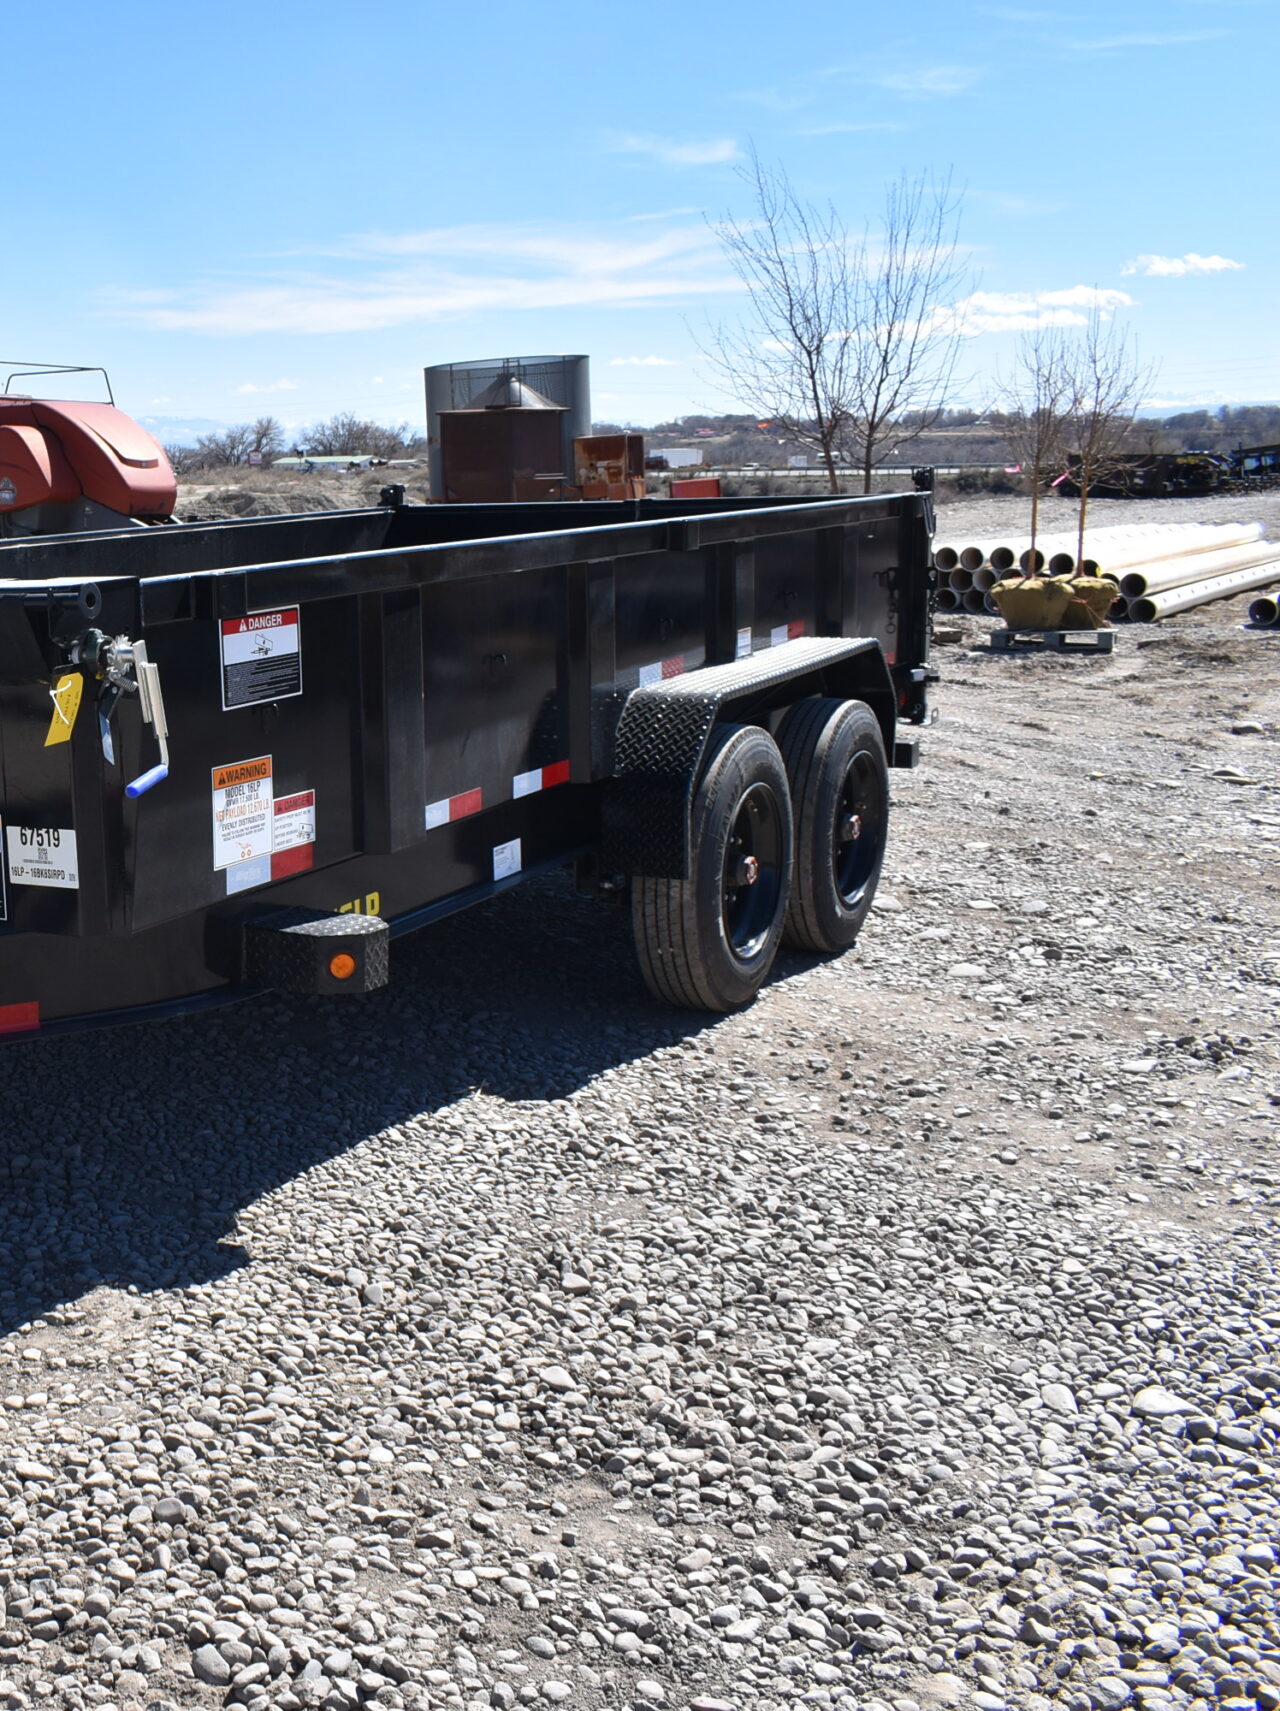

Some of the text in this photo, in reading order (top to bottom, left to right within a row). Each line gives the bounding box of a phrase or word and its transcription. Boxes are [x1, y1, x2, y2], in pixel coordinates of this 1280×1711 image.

[248, 614, 282, 630] DANGER
[225, 762, 267, 783] WARNING
[225, 785, 245, 799] MODEL
[286, 795, 310, 810] DANGER
[222, 813, 266, 831] EVENLY DISTRIBUTED
[20, 826, 60, 848] 67519
